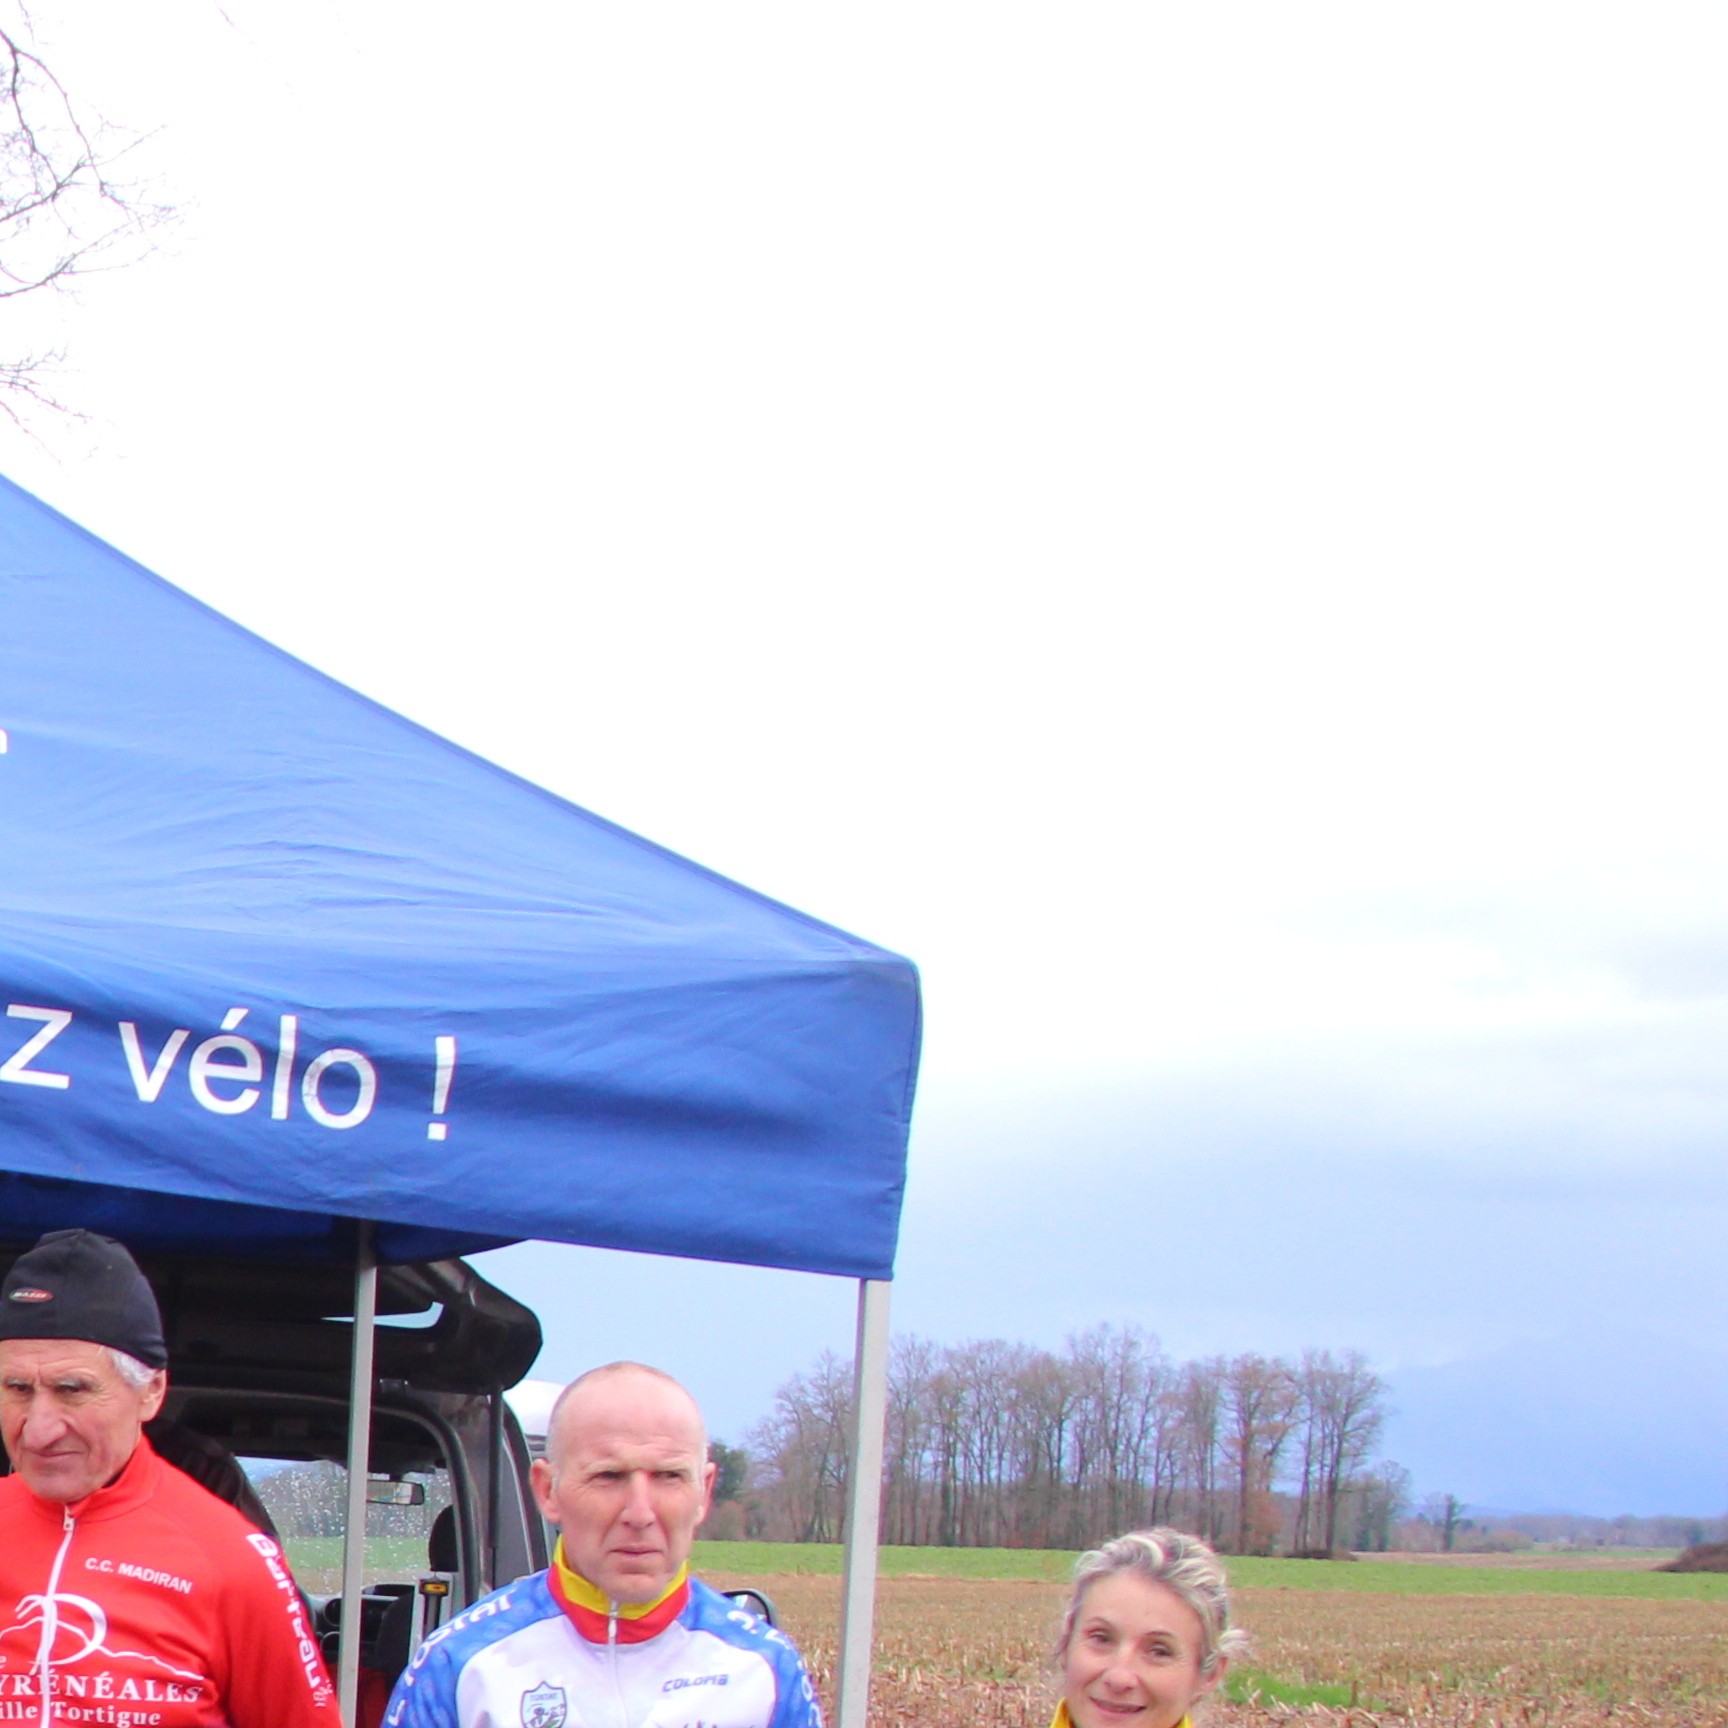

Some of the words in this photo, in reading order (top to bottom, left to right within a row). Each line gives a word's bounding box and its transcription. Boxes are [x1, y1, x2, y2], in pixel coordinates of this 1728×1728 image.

[119, 1008, 377, 1129] vélo
[426, 1035, 457, 1141] !
[85, 1558, 115, 1574] C.C.
[118, 1562, 192, 1594] MADIRAN
[50, 1701, 161, 1728] Tortigue
